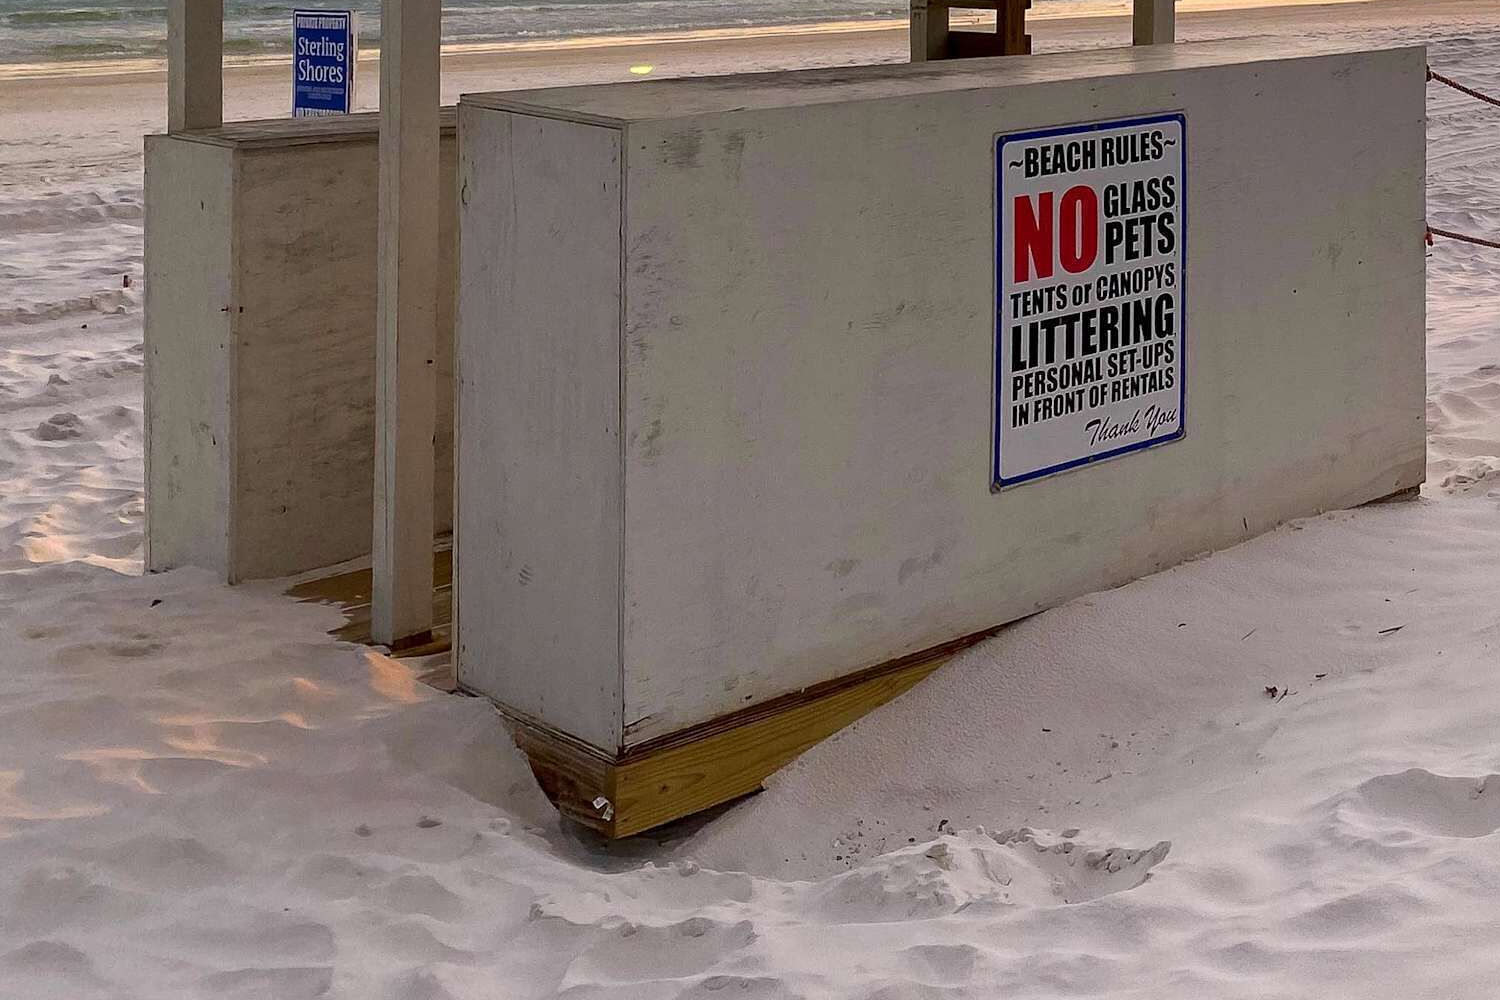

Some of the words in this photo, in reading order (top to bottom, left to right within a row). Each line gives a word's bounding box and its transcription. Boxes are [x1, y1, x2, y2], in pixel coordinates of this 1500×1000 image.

[298, 36, 344, 62] Sterling
[298, 59, 343, 83] Shores
[1014, 185, 1099, 283] NO
[1010, 284, 1067, 318] TENTS
[1072, 283, 1092, 306] or
[1012, 357, 1103, 401] PERSONAL
[1107, 339, 1175, 377] SET-UPS
[1012, 403, 1029, 428] IN
[1033, 389, 1085, 422] FRONT
[1089, 383, 1107, 408] OF
[1111, 366, 1174, 402] RENTALS
[1085, 410, 1141, 446] Thank
[1145, 404, 1177, 436] You
